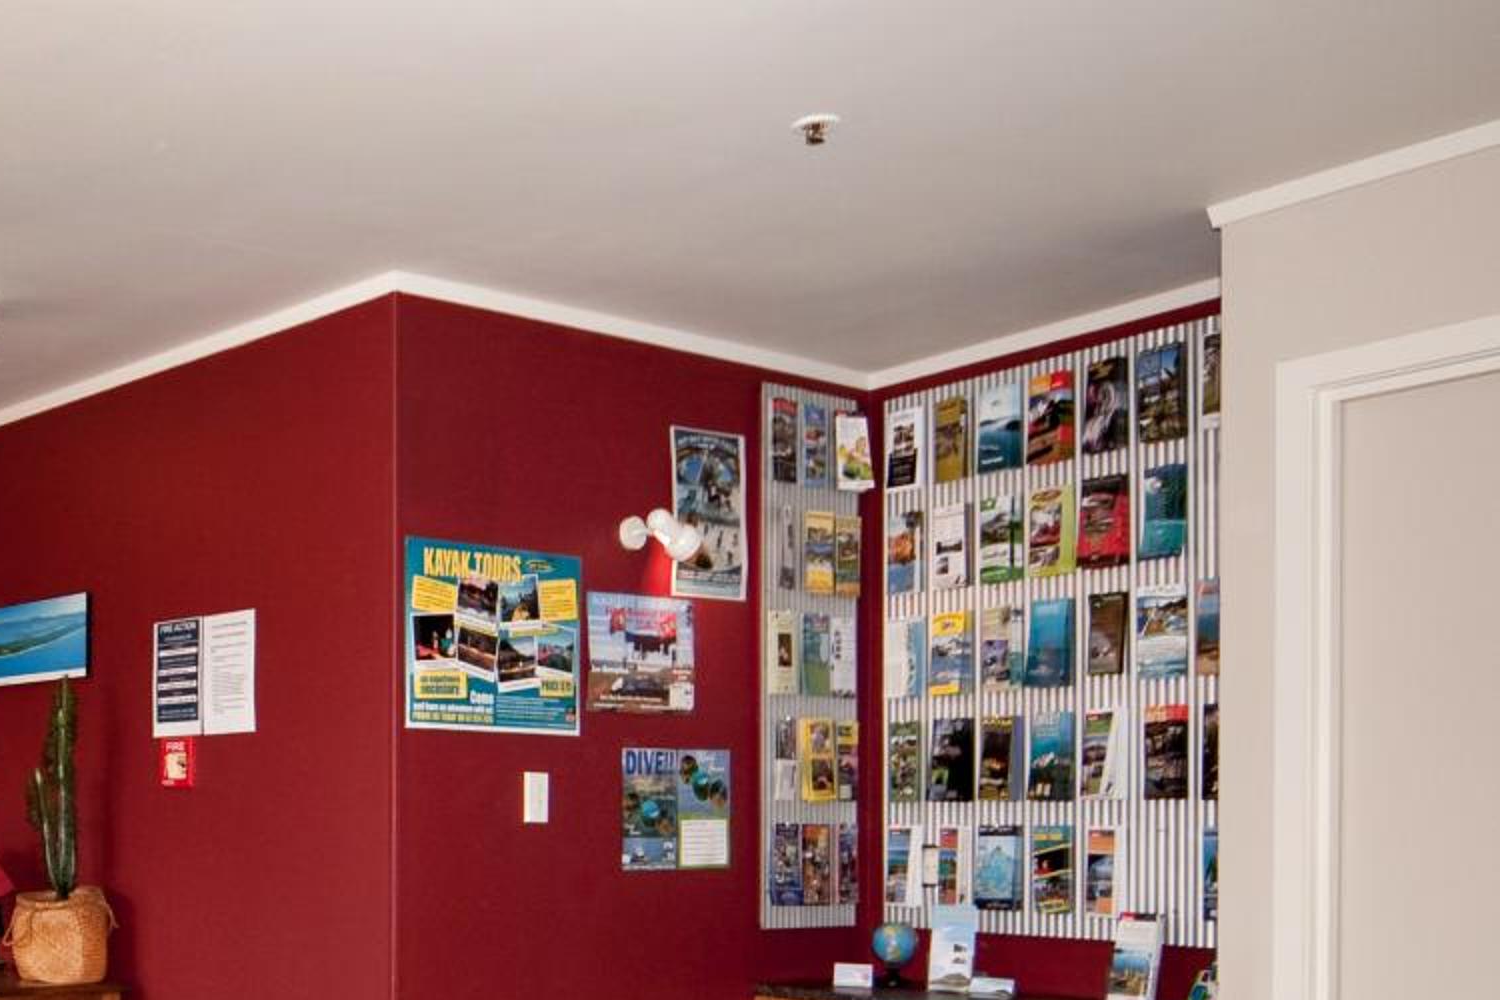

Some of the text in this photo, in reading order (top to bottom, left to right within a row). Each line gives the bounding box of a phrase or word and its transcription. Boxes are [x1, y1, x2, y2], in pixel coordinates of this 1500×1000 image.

[423, 547, 470, 577] KAYAK
[473, 552, 521, 582] TOURS
[165, 741, 185, 752] FIRE
